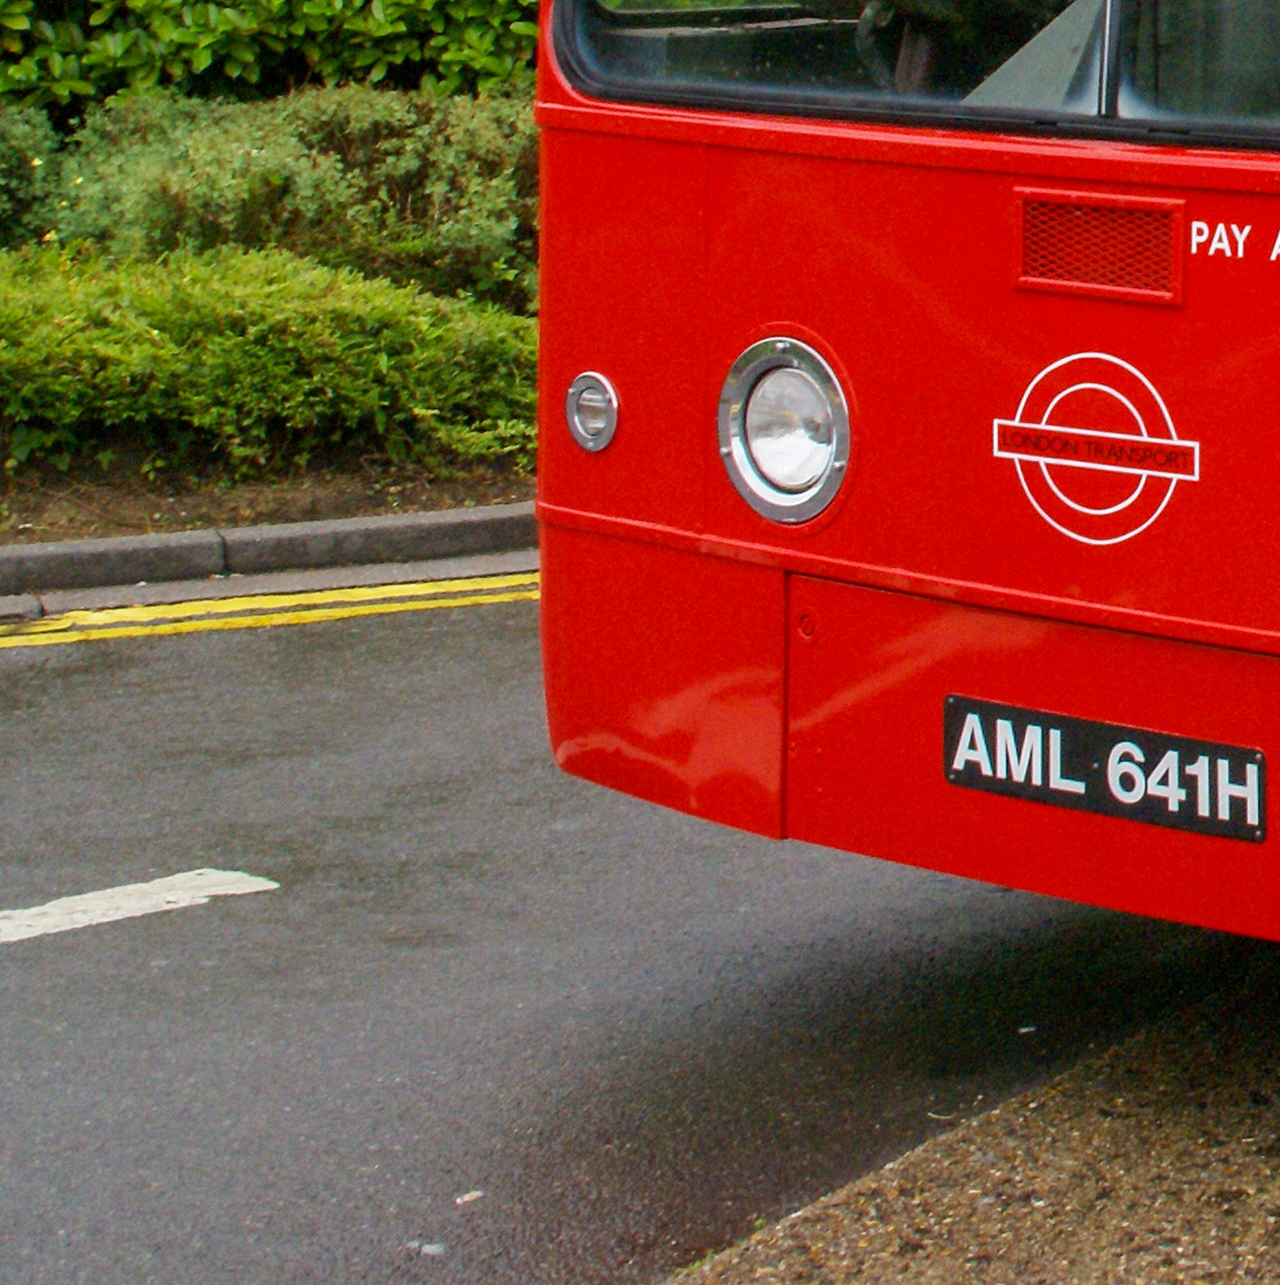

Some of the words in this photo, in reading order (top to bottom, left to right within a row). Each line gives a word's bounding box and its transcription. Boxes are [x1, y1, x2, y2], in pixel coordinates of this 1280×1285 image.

[1190, 221, 1252, 259] PAY
[1002, 431, 1077, 455] LONDON
[1084, 440, 1188, 468] TRANSPORT
[951, 713, 1087, 795] AML
[1107, 740, 1260, 826] 641H
